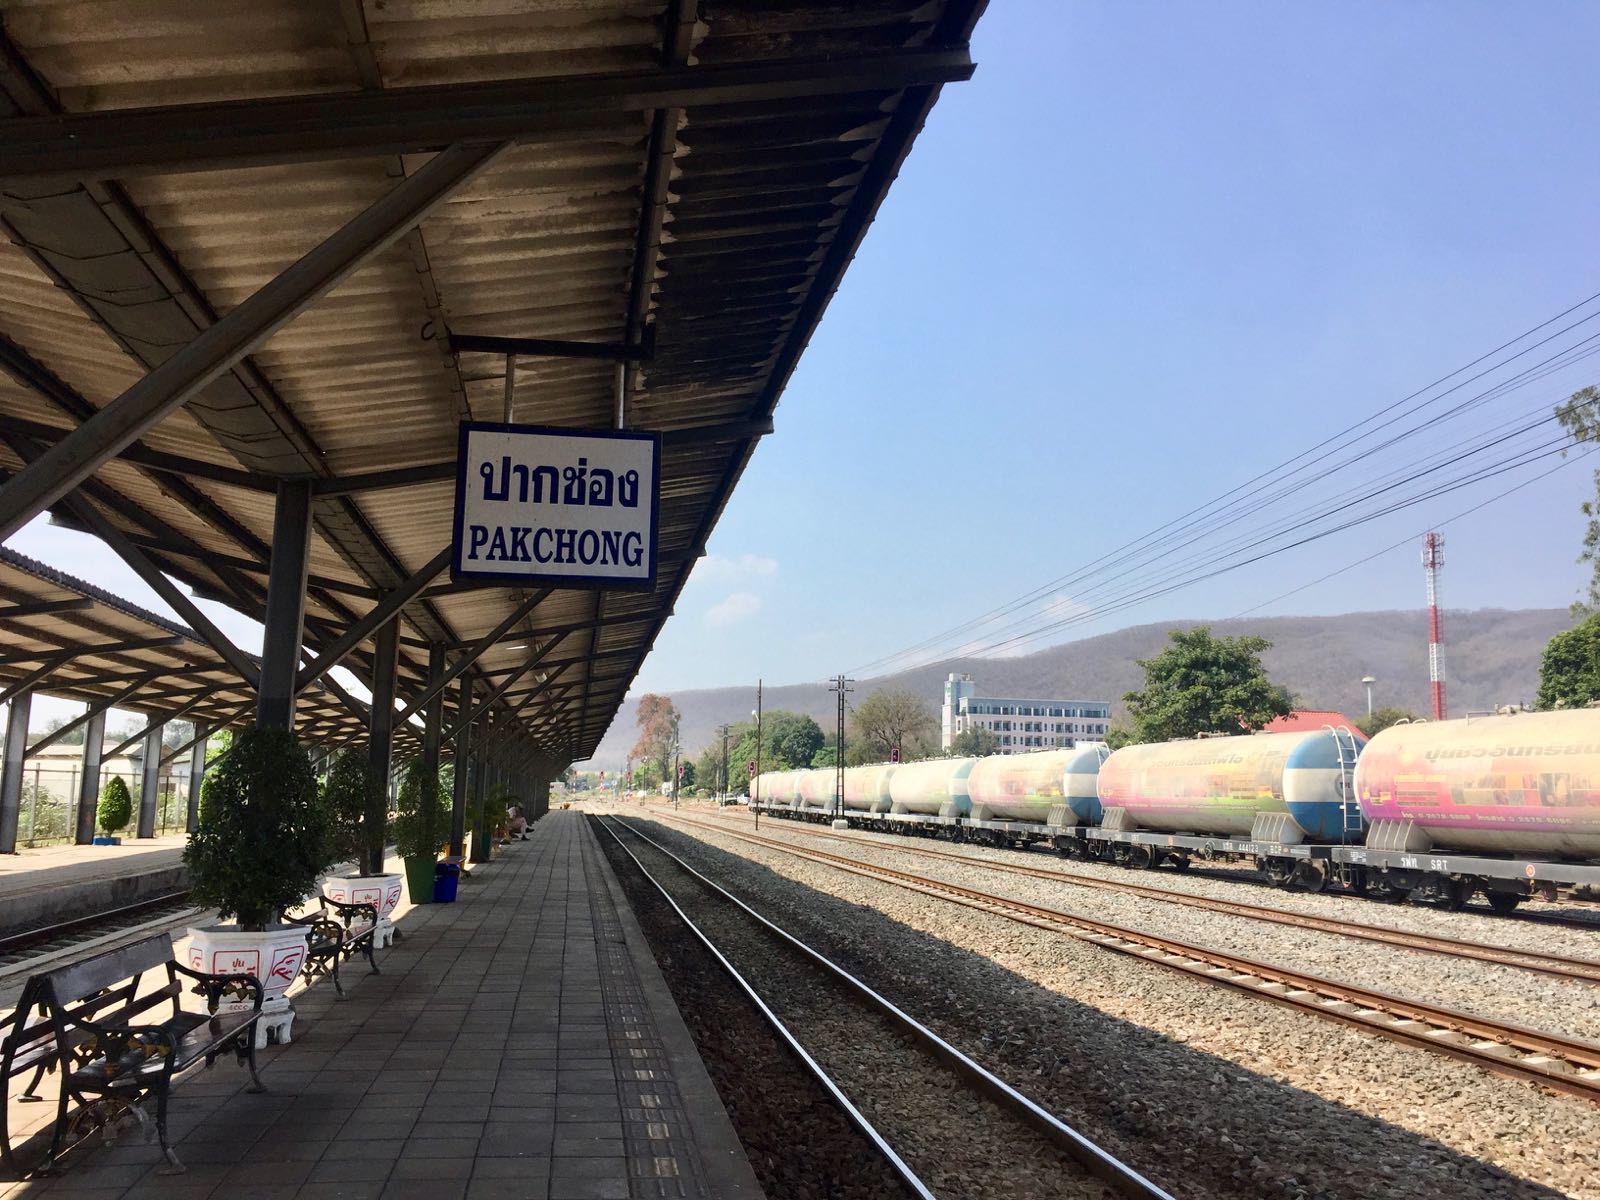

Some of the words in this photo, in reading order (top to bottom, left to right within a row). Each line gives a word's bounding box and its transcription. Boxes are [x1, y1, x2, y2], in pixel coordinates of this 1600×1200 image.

[479, 456, 639, 508] ปากช่อง
[467, 525, 644, 567] PAKCHONG
[1430, 859, 1448, 871] SRT
